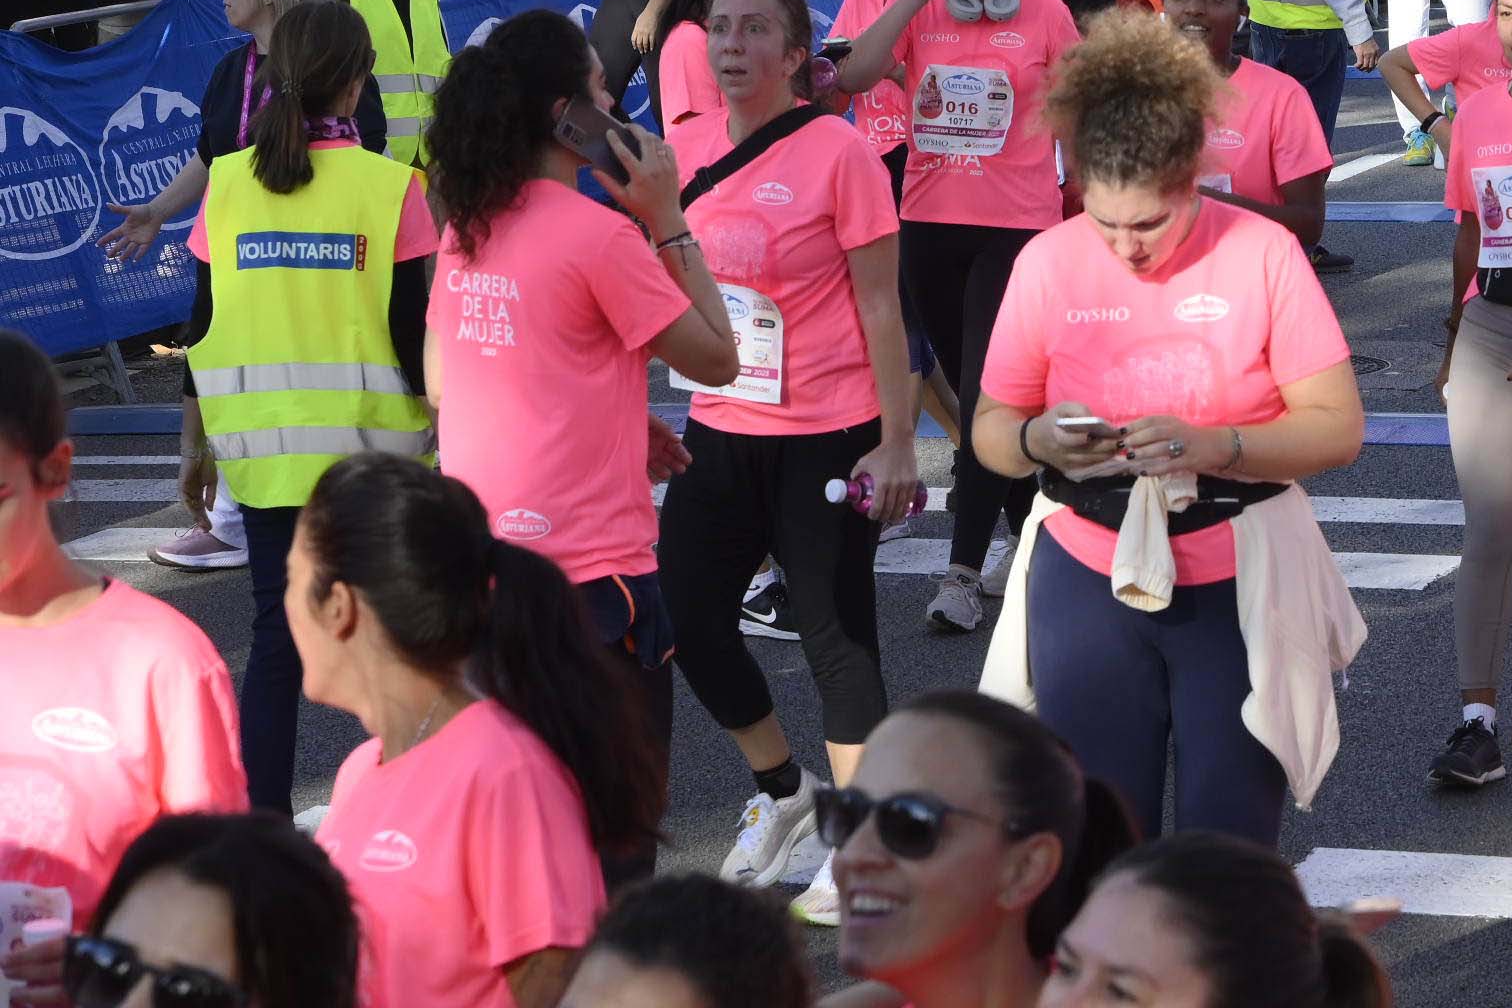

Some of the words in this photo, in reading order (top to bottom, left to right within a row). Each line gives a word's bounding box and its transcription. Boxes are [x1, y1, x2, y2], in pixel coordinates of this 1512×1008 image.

[920, 33, 960, 43] OYSHO
[945, 100, 979, 115] 016
[948, 116, 974, 127] 10717
[123, 136, 164, 156] CENTRAL
[918, 137, 949, 147] OYSHO
[1476, 143, 1512, 159] OYSHO
[237, 241, 352, 261] VOLUNTARIS
[447, 269, 520, 302] CARRERA
[462, 294, 482, 320] DE
[489, 299, 510, 323] LA
[1066, 306, 1131, 325] OYSHO
[456, 318, 516, 347] MUJER
